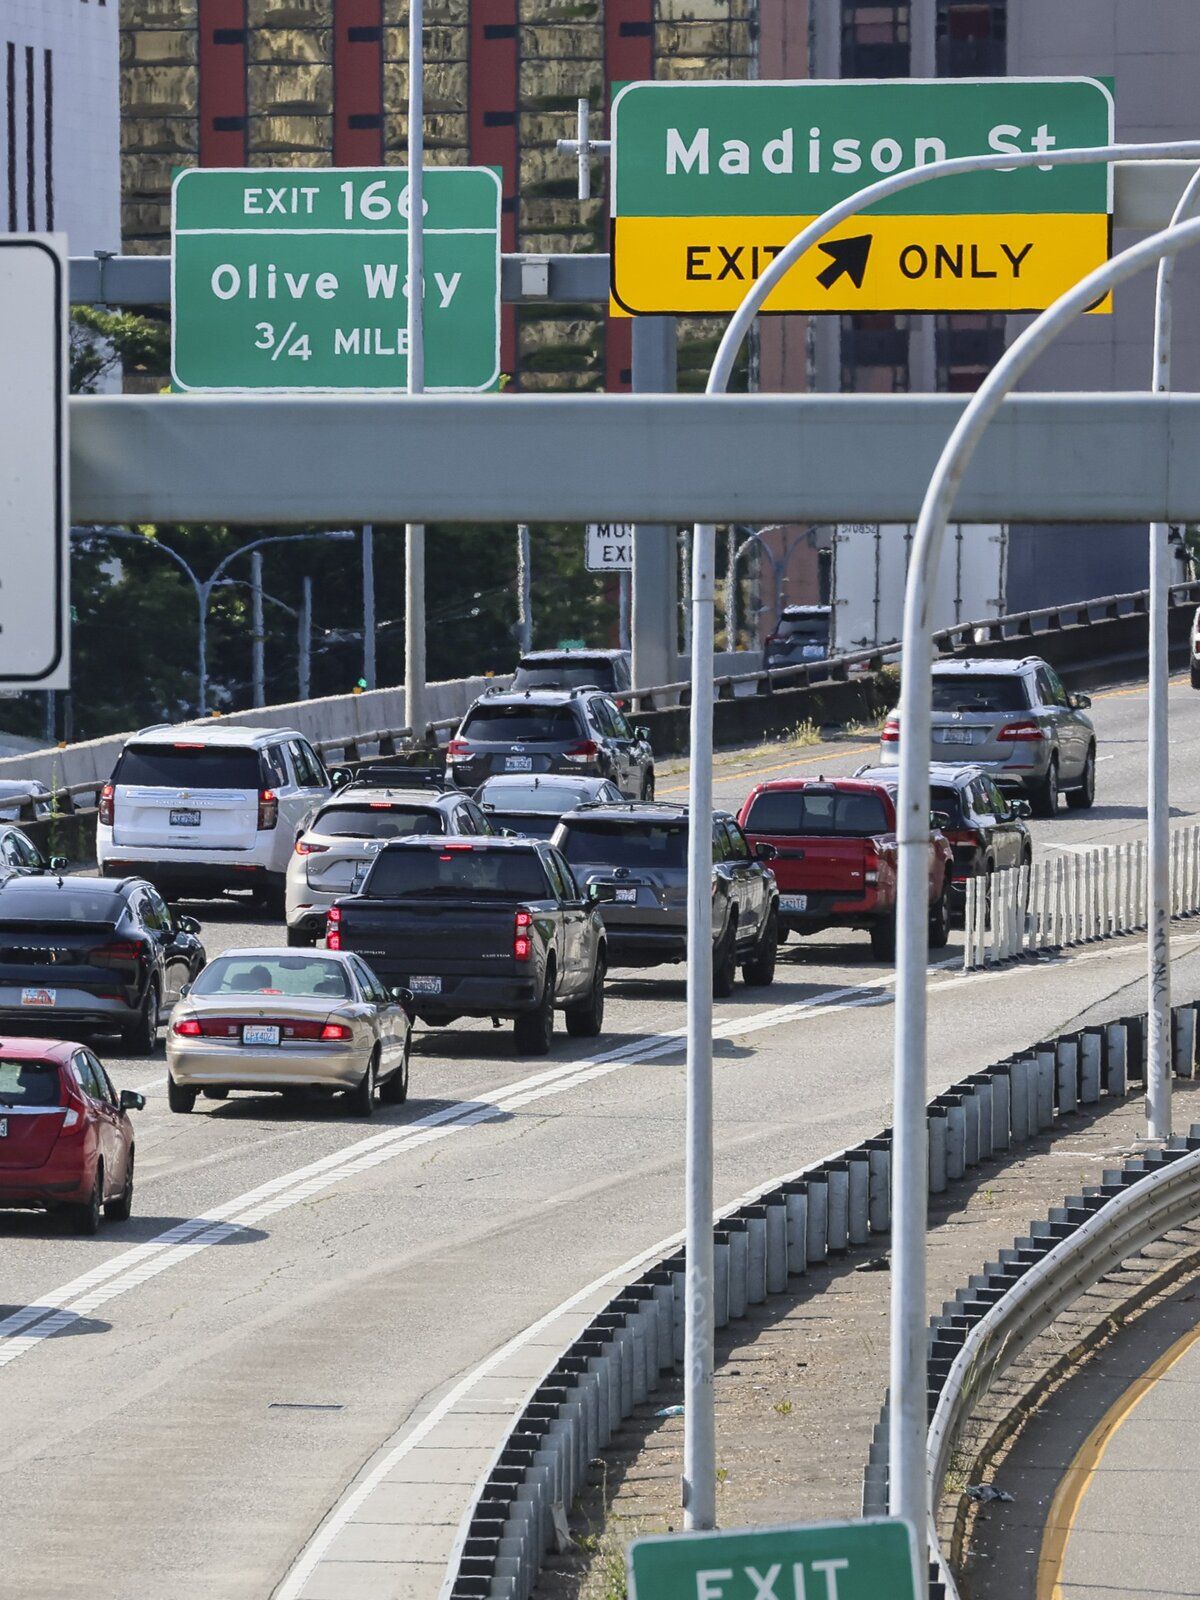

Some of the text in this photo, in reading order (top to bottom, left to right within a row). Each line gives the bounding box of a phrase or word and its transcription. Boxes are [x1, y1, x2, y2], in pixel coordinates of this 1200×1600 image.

[666, 123, 1056, 175] Madison St
[243, 180, 429, 221] EXIT 166
[211, 263, 339, 300] Olive
[899, 243, 1035, 280] ONLY
[254, 321, 409, 361] 3/4 MILE
[696, 1557, 850, 1600] EXIT
